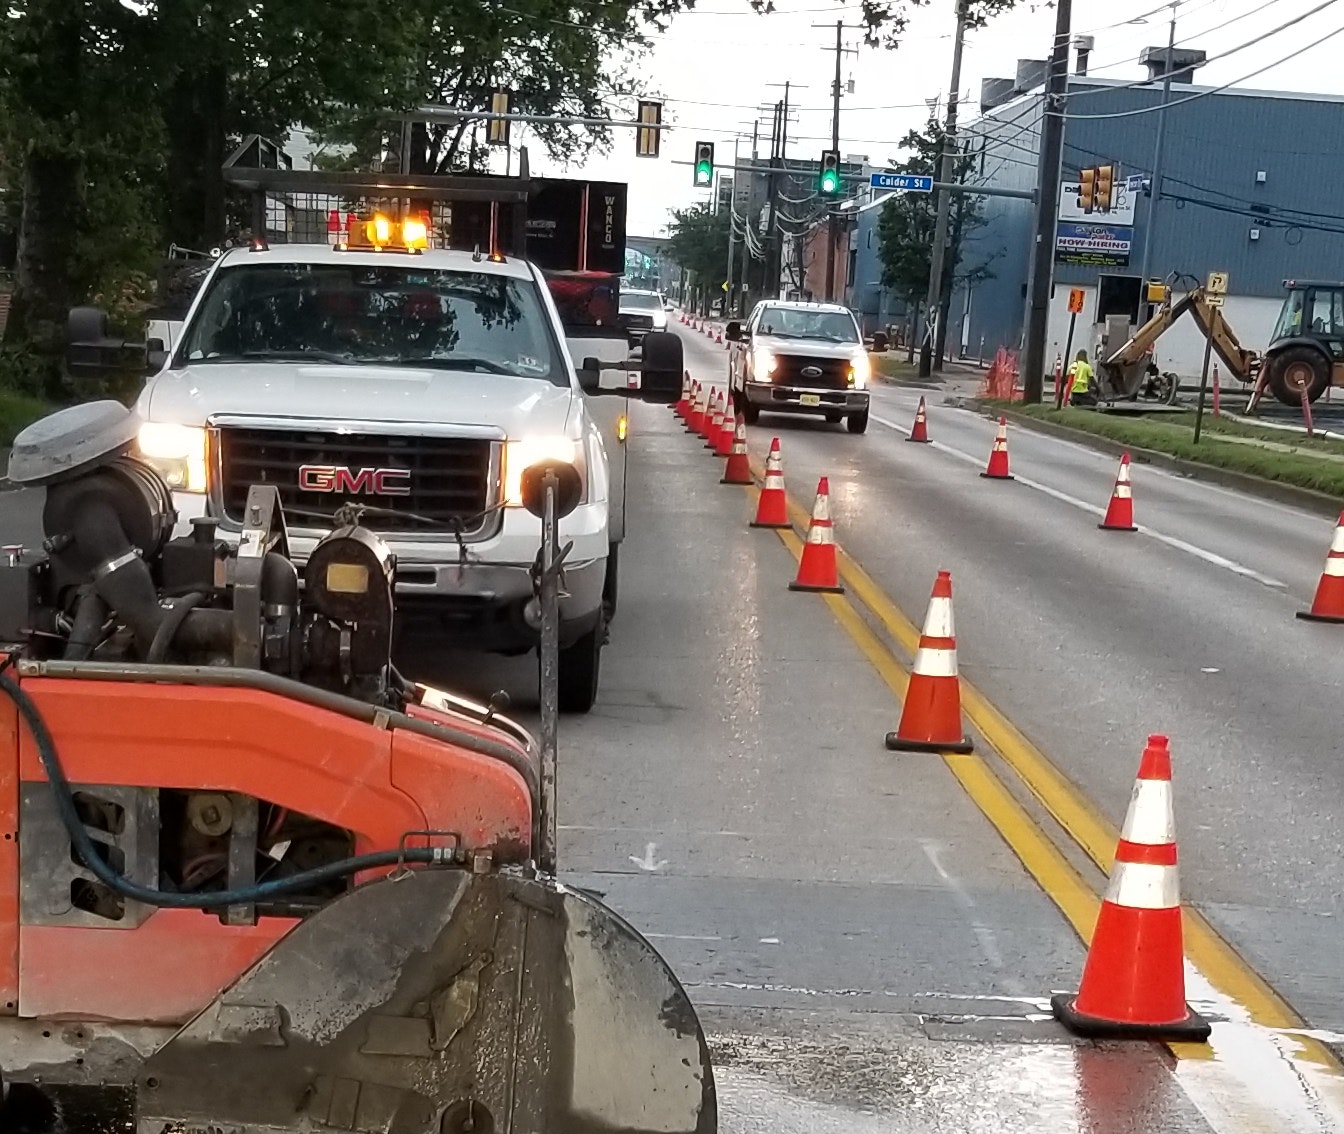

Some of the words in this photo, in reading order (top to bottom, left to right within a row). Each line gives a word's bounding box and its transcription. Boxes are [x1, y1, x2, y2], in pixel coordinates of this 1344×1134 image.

[914, 178, 924, 188] St
[604, 196, 616, 243] WANCO
[1088, 240, 1129, 249] HIRING
[299, 465, 411, 496] GMC
